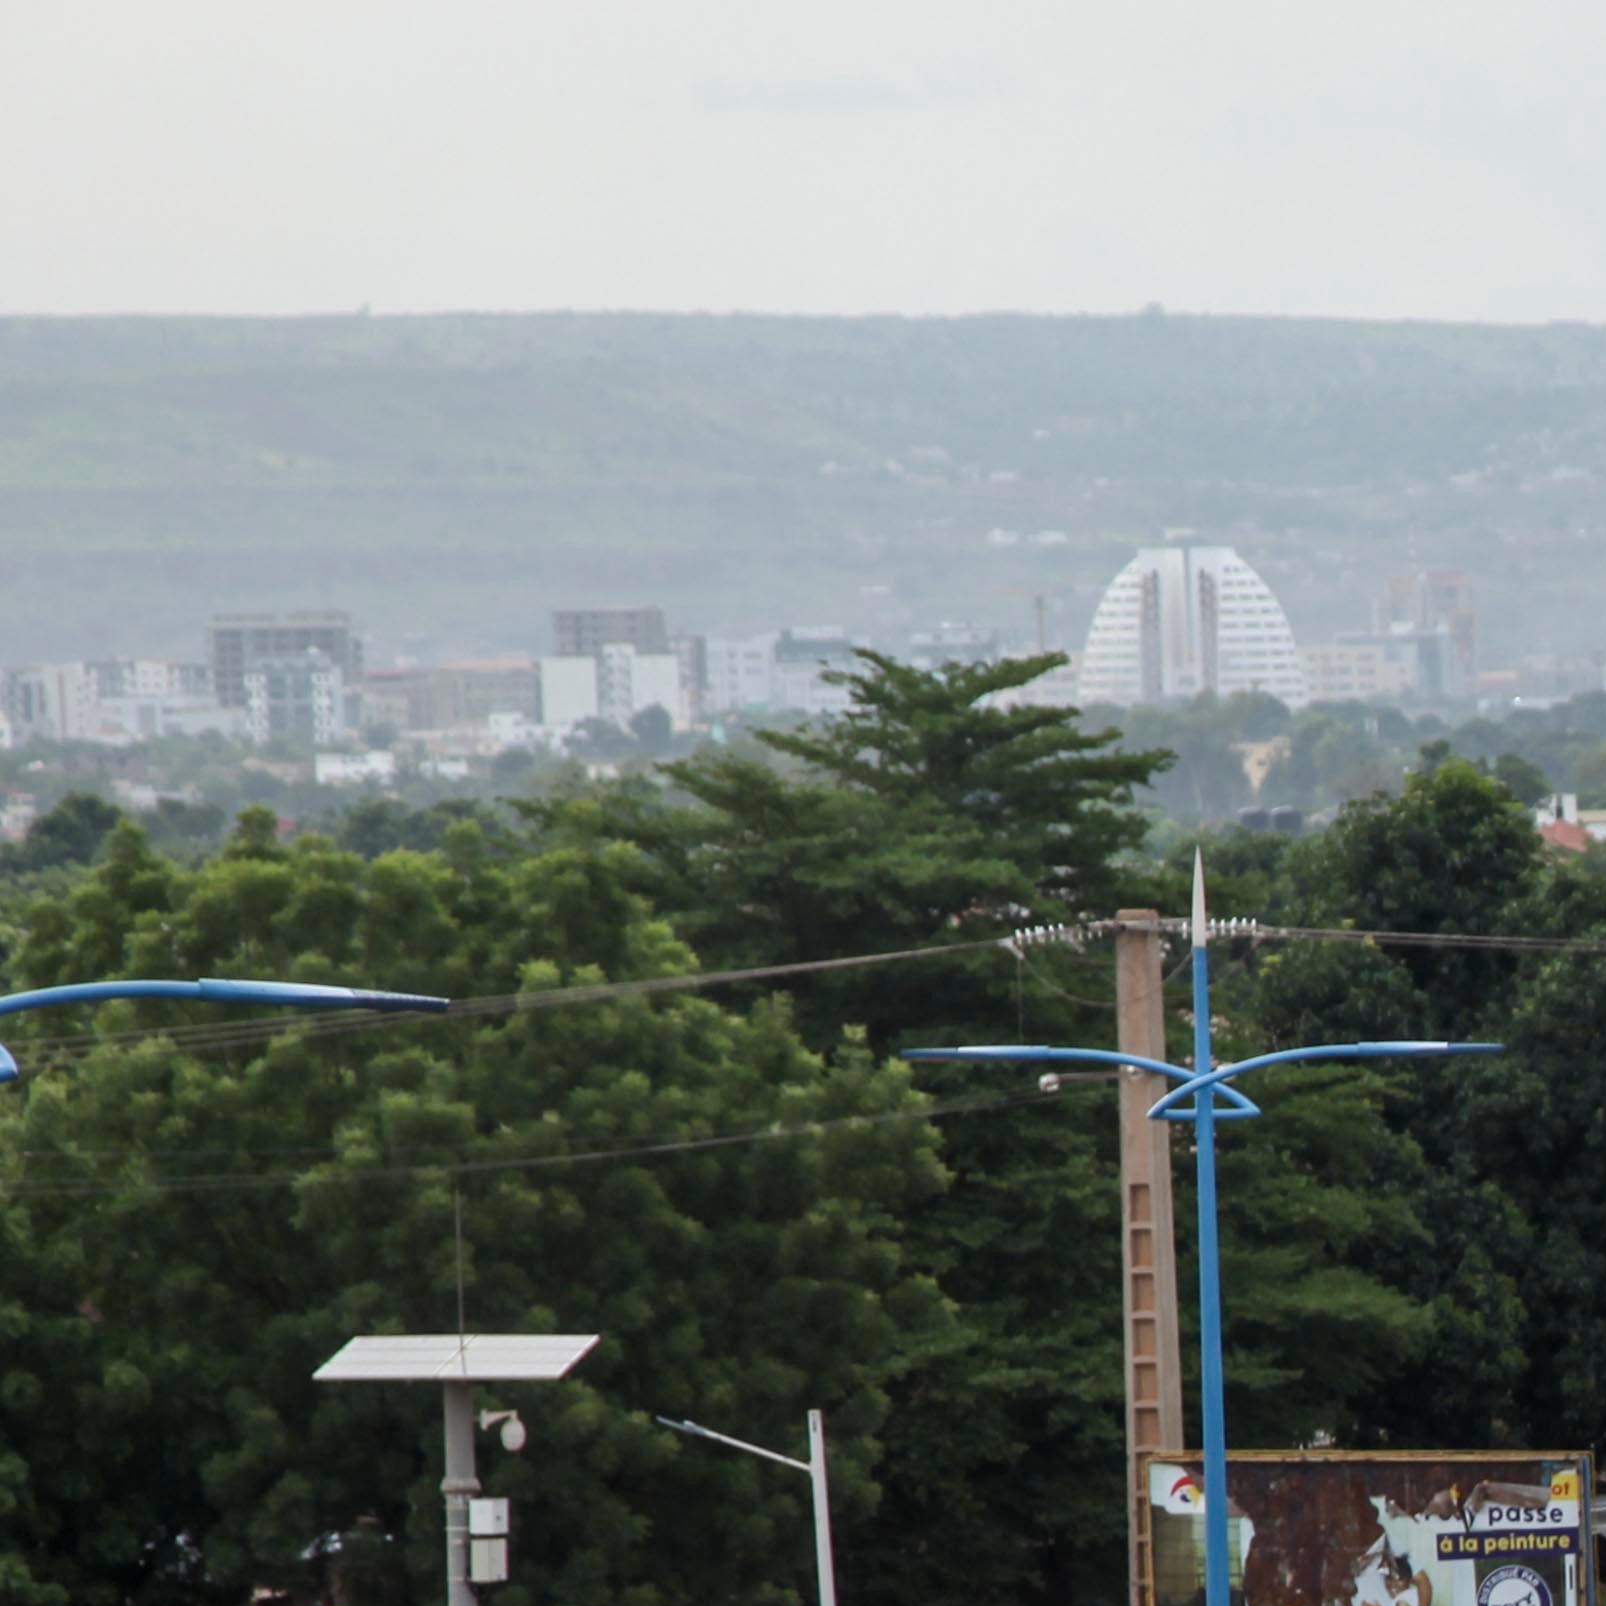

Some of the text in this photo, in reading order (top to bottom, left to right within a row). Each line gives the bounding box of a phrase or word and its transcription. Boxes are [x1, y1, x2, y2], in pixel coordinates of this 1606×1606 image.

[1488, 1506, 1564, 1526] passe
[1459, 1535, 1479, 1552] la
[1484, 1533, 1571, 1555] peinture
